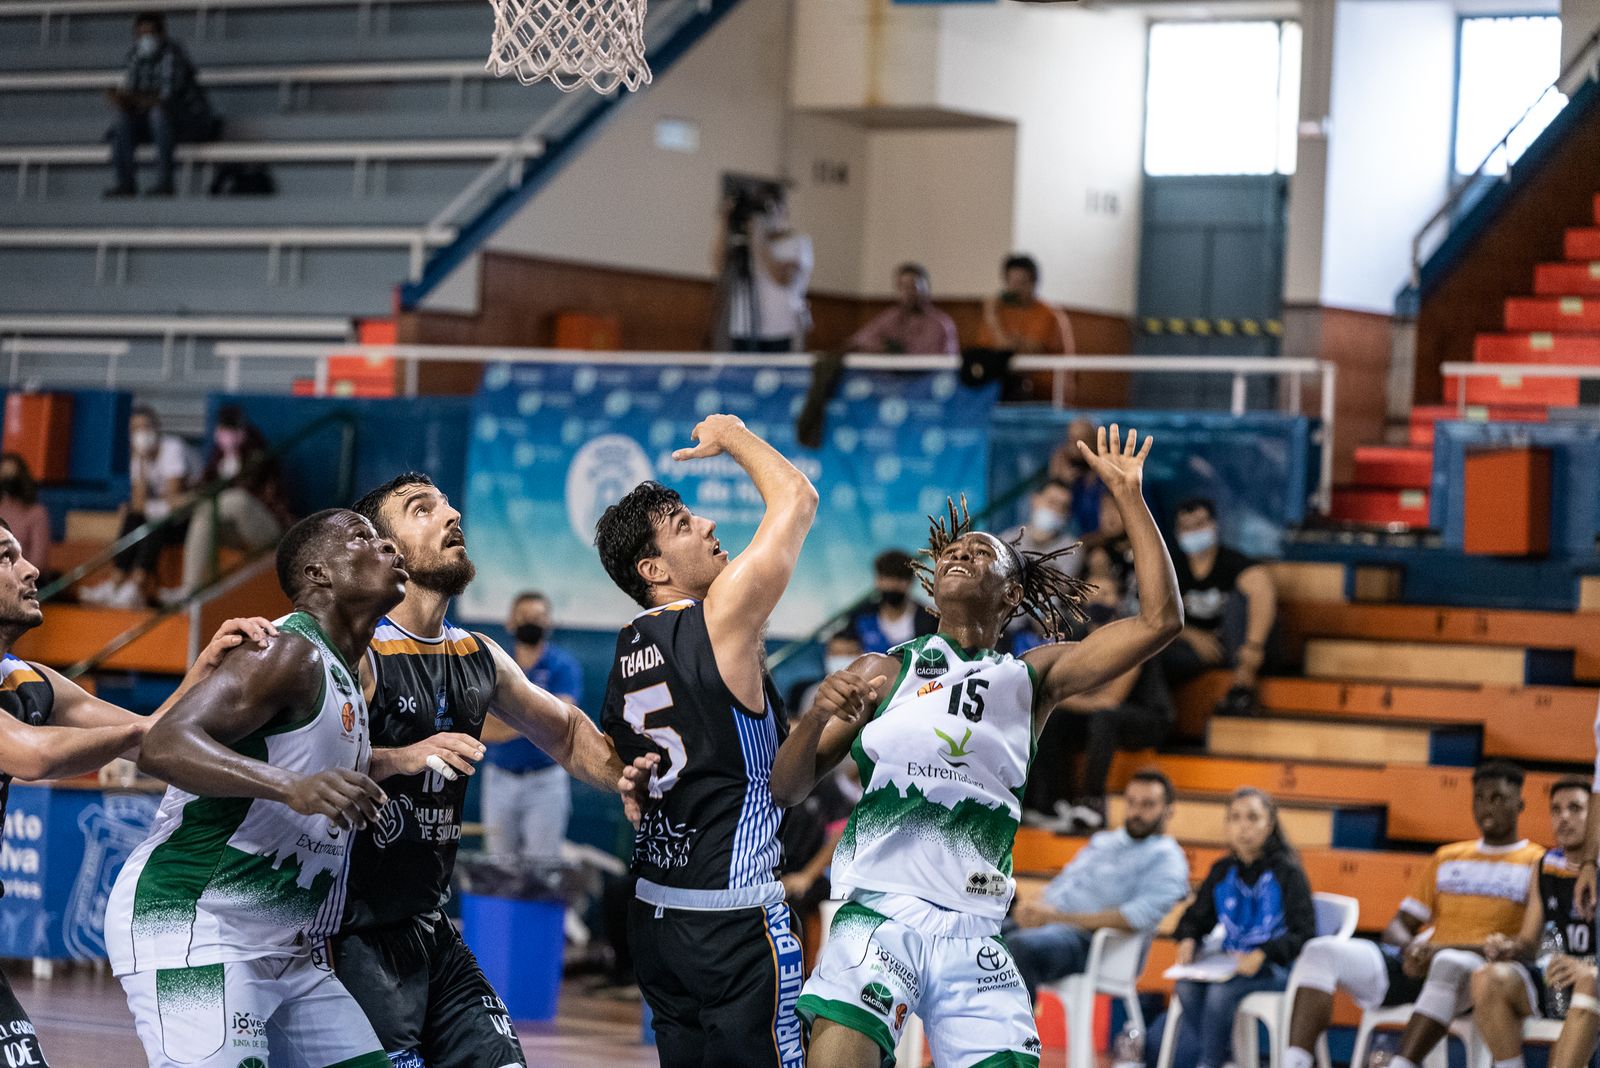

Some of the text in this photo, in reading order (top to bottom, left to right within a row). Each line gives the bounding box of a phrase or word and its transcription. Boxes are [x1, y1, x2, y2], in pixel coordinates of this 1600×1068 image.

[947, 678, 990, 723] 15
[623, 681, 688, 800] 5
[1566, 923, 1590, 952] 10
[976, 968, 1018, 984] TOYOTA
